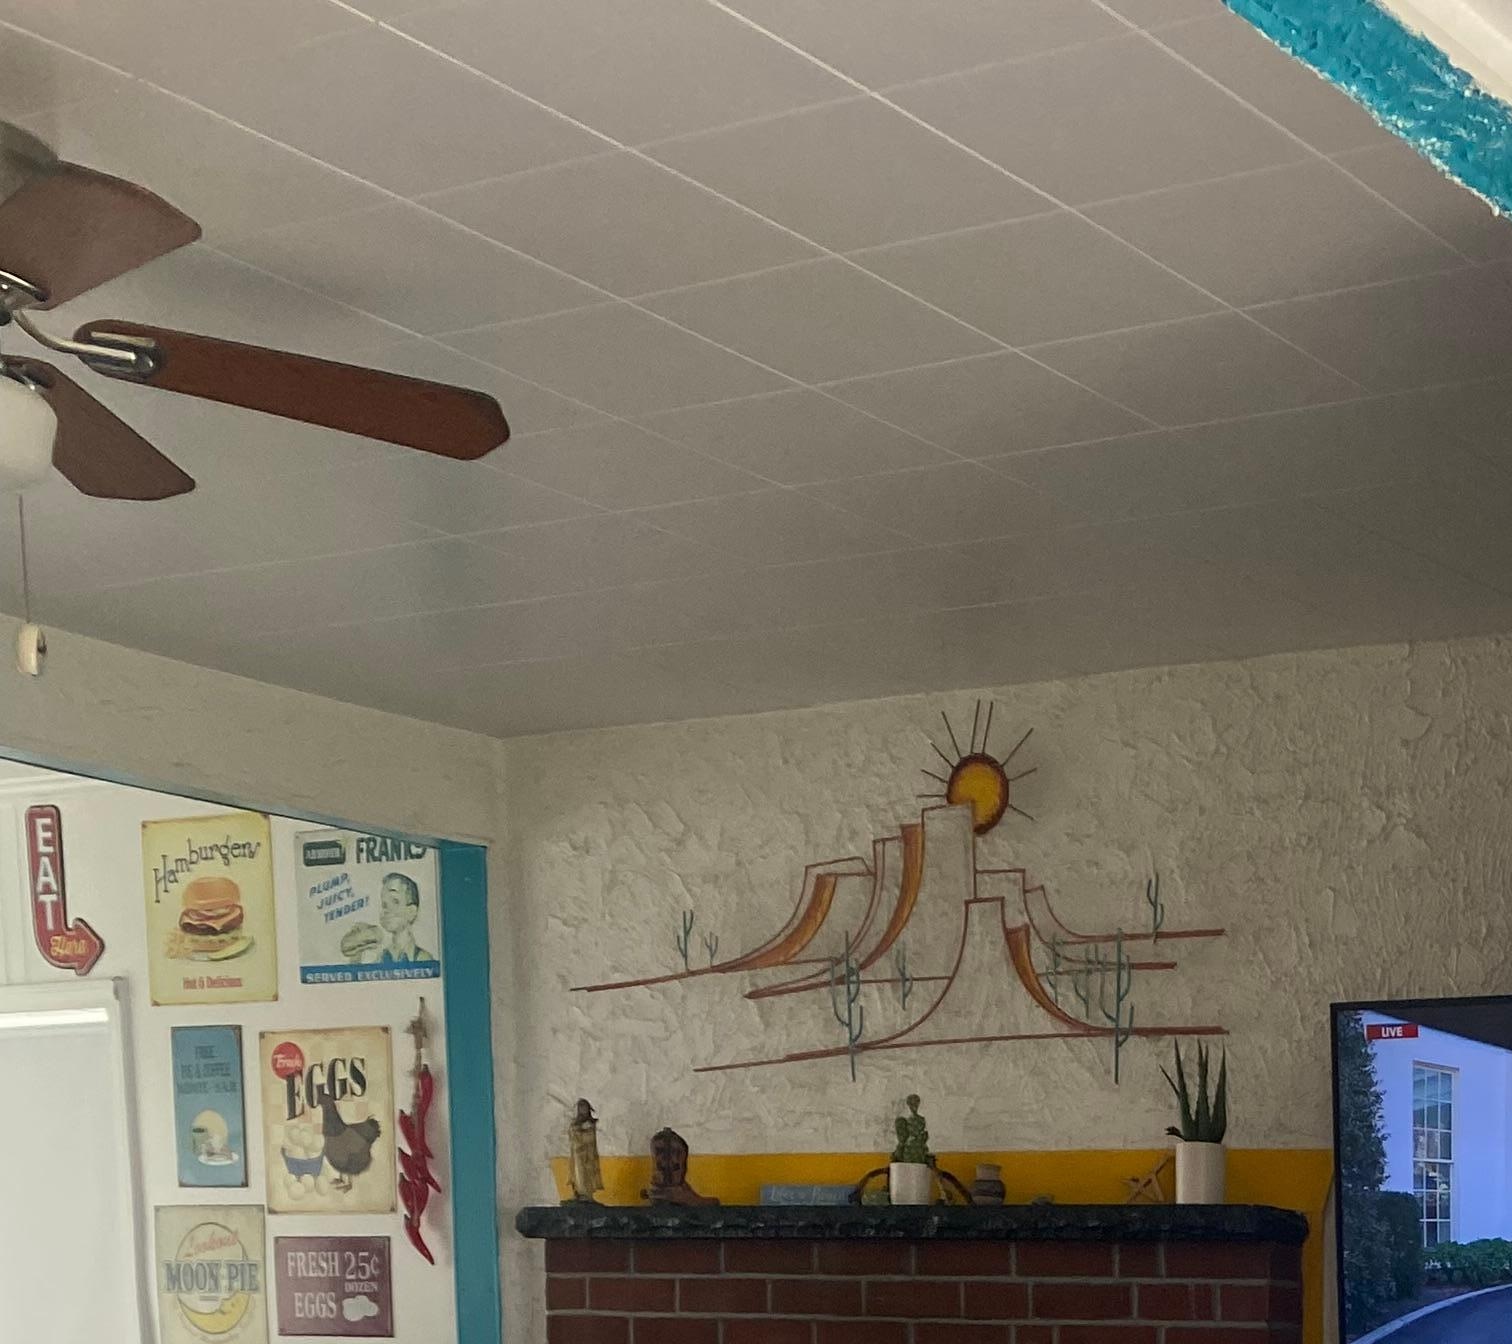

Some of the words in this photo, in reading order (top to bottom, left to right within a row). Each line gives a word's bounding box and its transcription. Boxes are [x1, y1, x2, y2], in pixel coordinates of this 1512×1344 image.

[35, 817, 59, 931] EAT
[153, 835, 261, 903] Hamburgers
[306, 972, 352, 983] SERVED
[357, 967, 434, 981] EXCLUSIVELY
[1381, 1026, 1403, 1038] LIVE
[286, 1057, 367, 1121] EGGS
[165, 1262, 221, 1292] MOON
[227, 1262, 259, 1292] PIE
[287, 1251, 341, 1278] FRESH
[344, 1281, 378, 1293] DOZEN
[294, 1291, 337, 1319] EGGS
